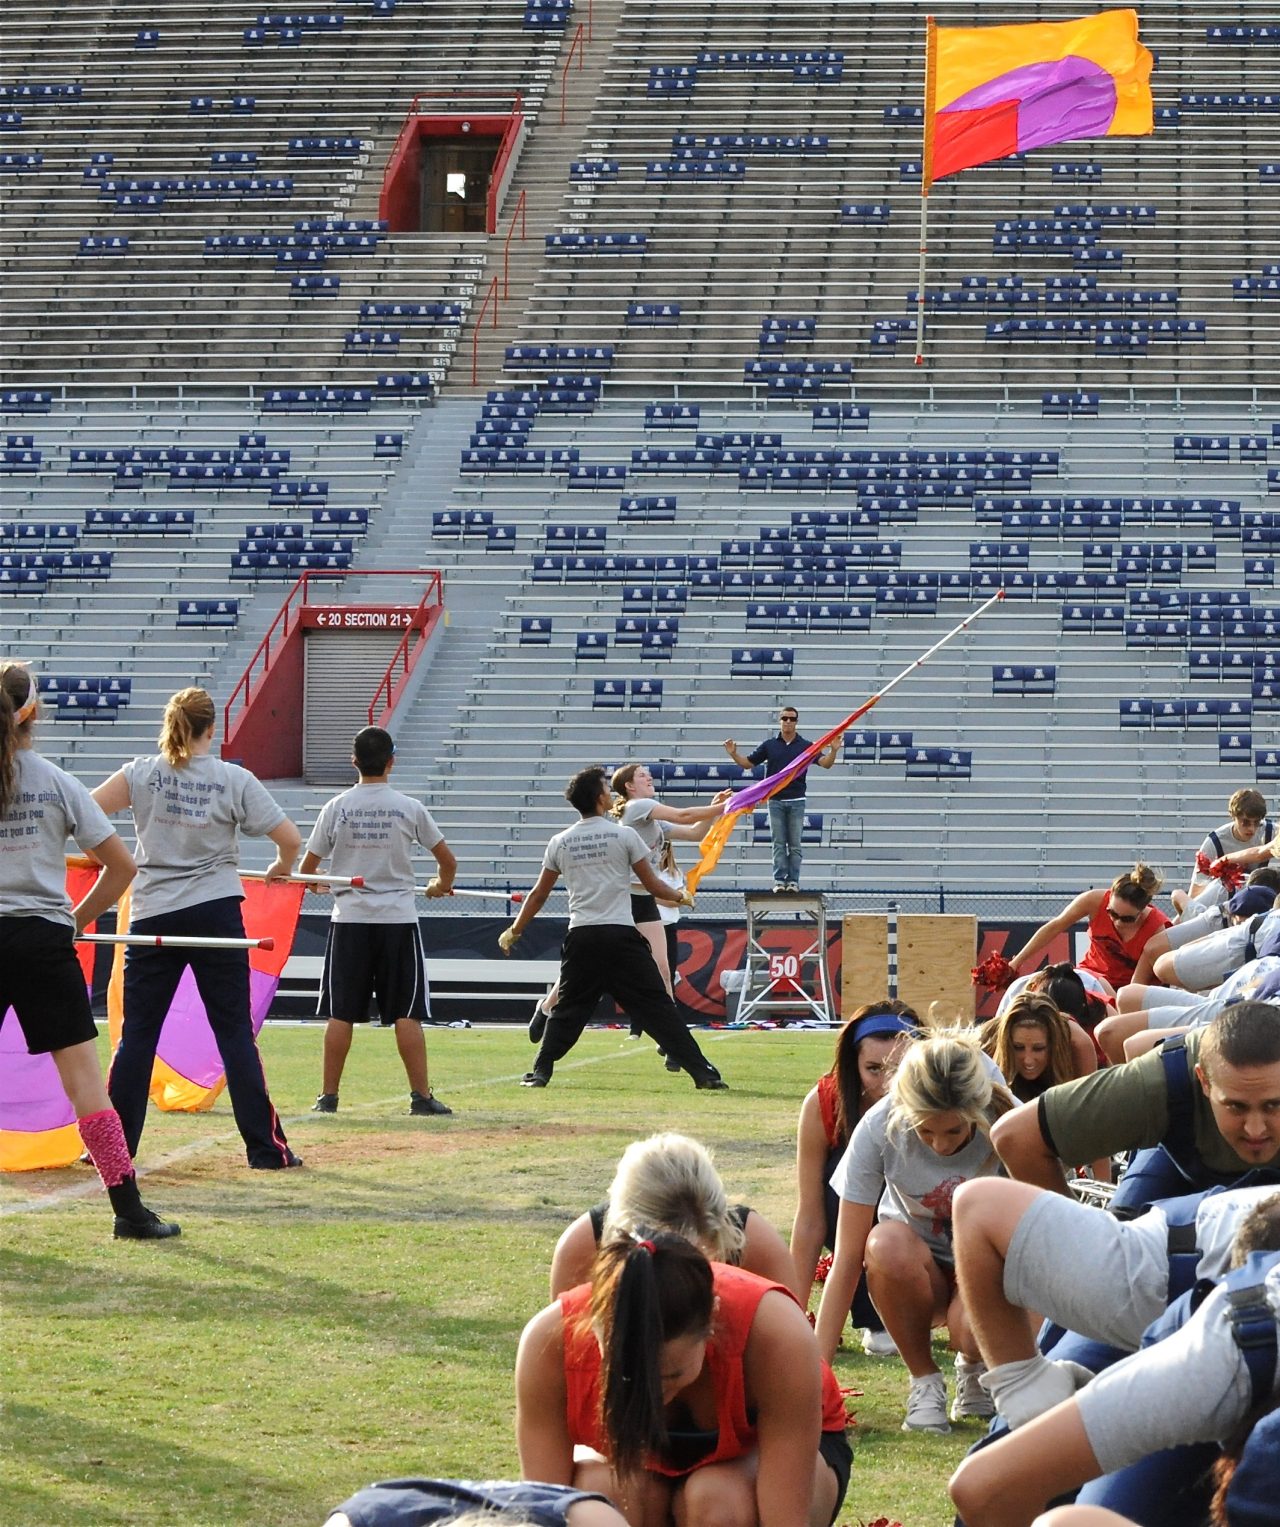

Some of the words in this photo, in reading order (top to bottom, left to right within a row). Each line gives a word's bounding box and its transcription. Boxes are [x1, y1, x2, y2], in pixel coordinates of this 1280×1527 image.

[328, 613, 341, 626] 20
[344, 613, 387, 626] SECTION
[390, 613, 401, 626] 21
[23, 791, 36, 803] the
[6, 809, 27, 821] akes
[29, 809, 44, 821] you
[10, 827, 24, 839] you
[771, 955, 798, 978] 50
